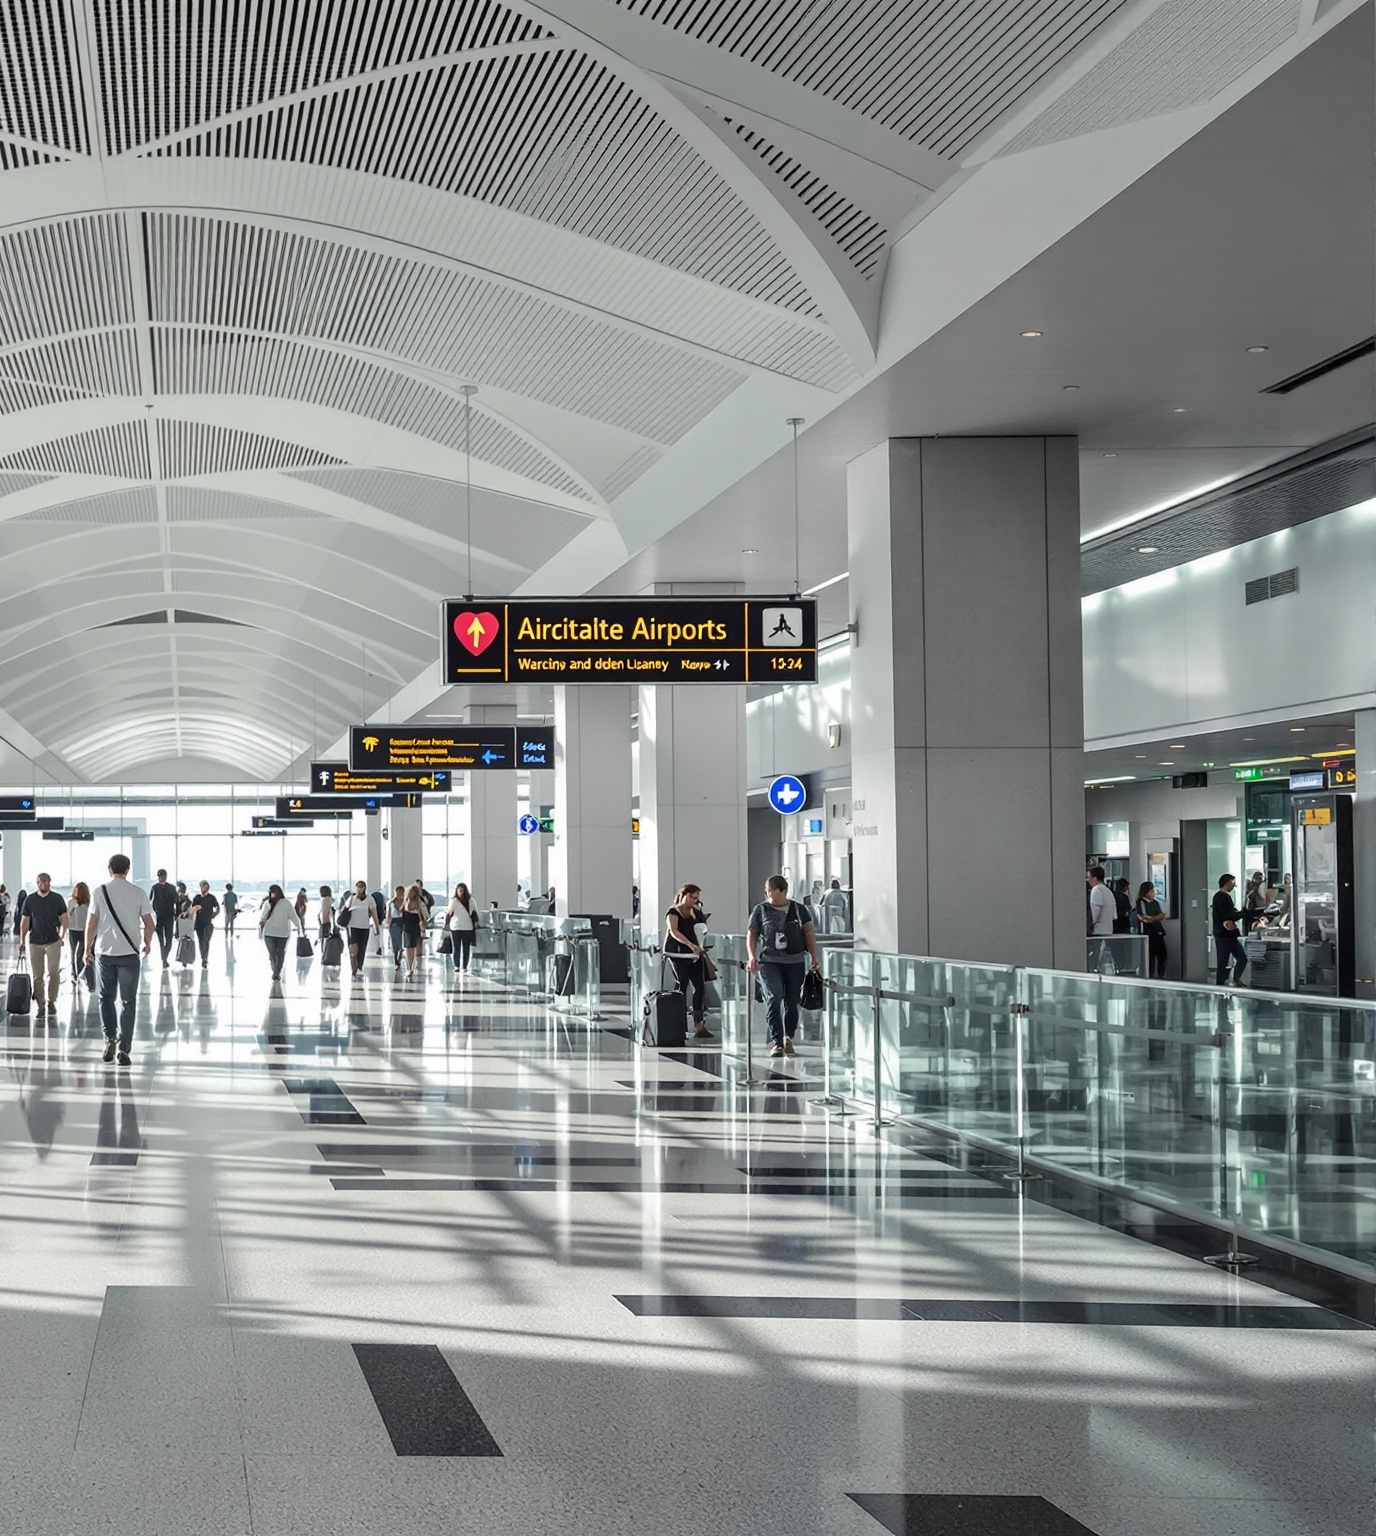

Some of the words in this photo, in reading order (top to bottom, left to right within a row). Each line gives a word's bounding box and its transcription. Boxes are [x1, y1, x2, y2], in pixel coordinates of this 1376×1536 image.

[517, 616, 624, 641] Aircitalte
[631, 616, 727, 646] Airports
[569, 657, 592, 670] and
